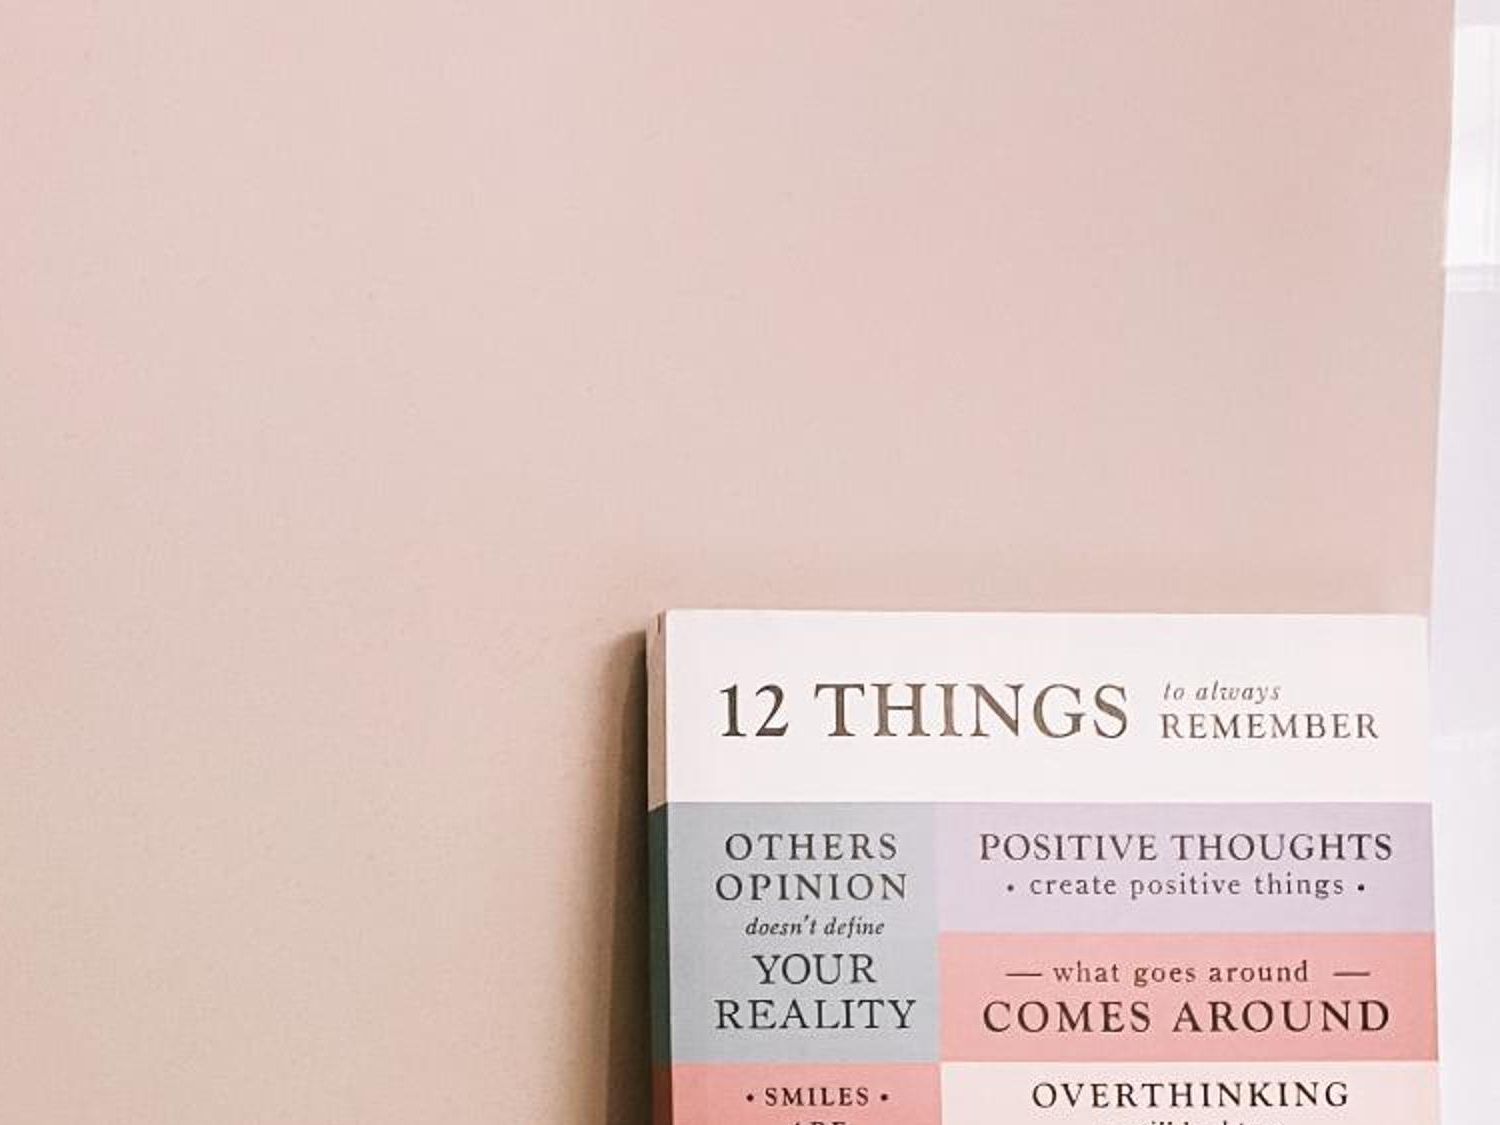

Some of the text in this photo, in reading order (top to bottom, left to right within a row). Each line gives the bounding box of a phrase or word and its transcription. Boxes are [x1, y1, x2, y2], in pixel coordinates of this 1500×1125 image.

[1163, 679, 1281, 705] to always
[720, 682, 1128, 739] 12 THINGS
[1160, 713, 1379, 739] REMEMBER
[725, 833, 897, 861] OTHERS
[980, 833, 1392, 861] POSITIVE THOUGHTS
[715, 873, 907, 901] OPINION
[1029, 871, 1344, 901] create positive things
[744, 914, 885, 939] doesn't define
[751, 953, 877, 985] YOUR
[1052, 959, 1308, 988] what goes around
[714, 998, 917, 1030] REALITY
[983, 999, 1389, 1033] COMES AROUND
[765, 1087, 869, 1107] SMILES
[1032, 1081, 1348, 1109] OVERTHINKING
